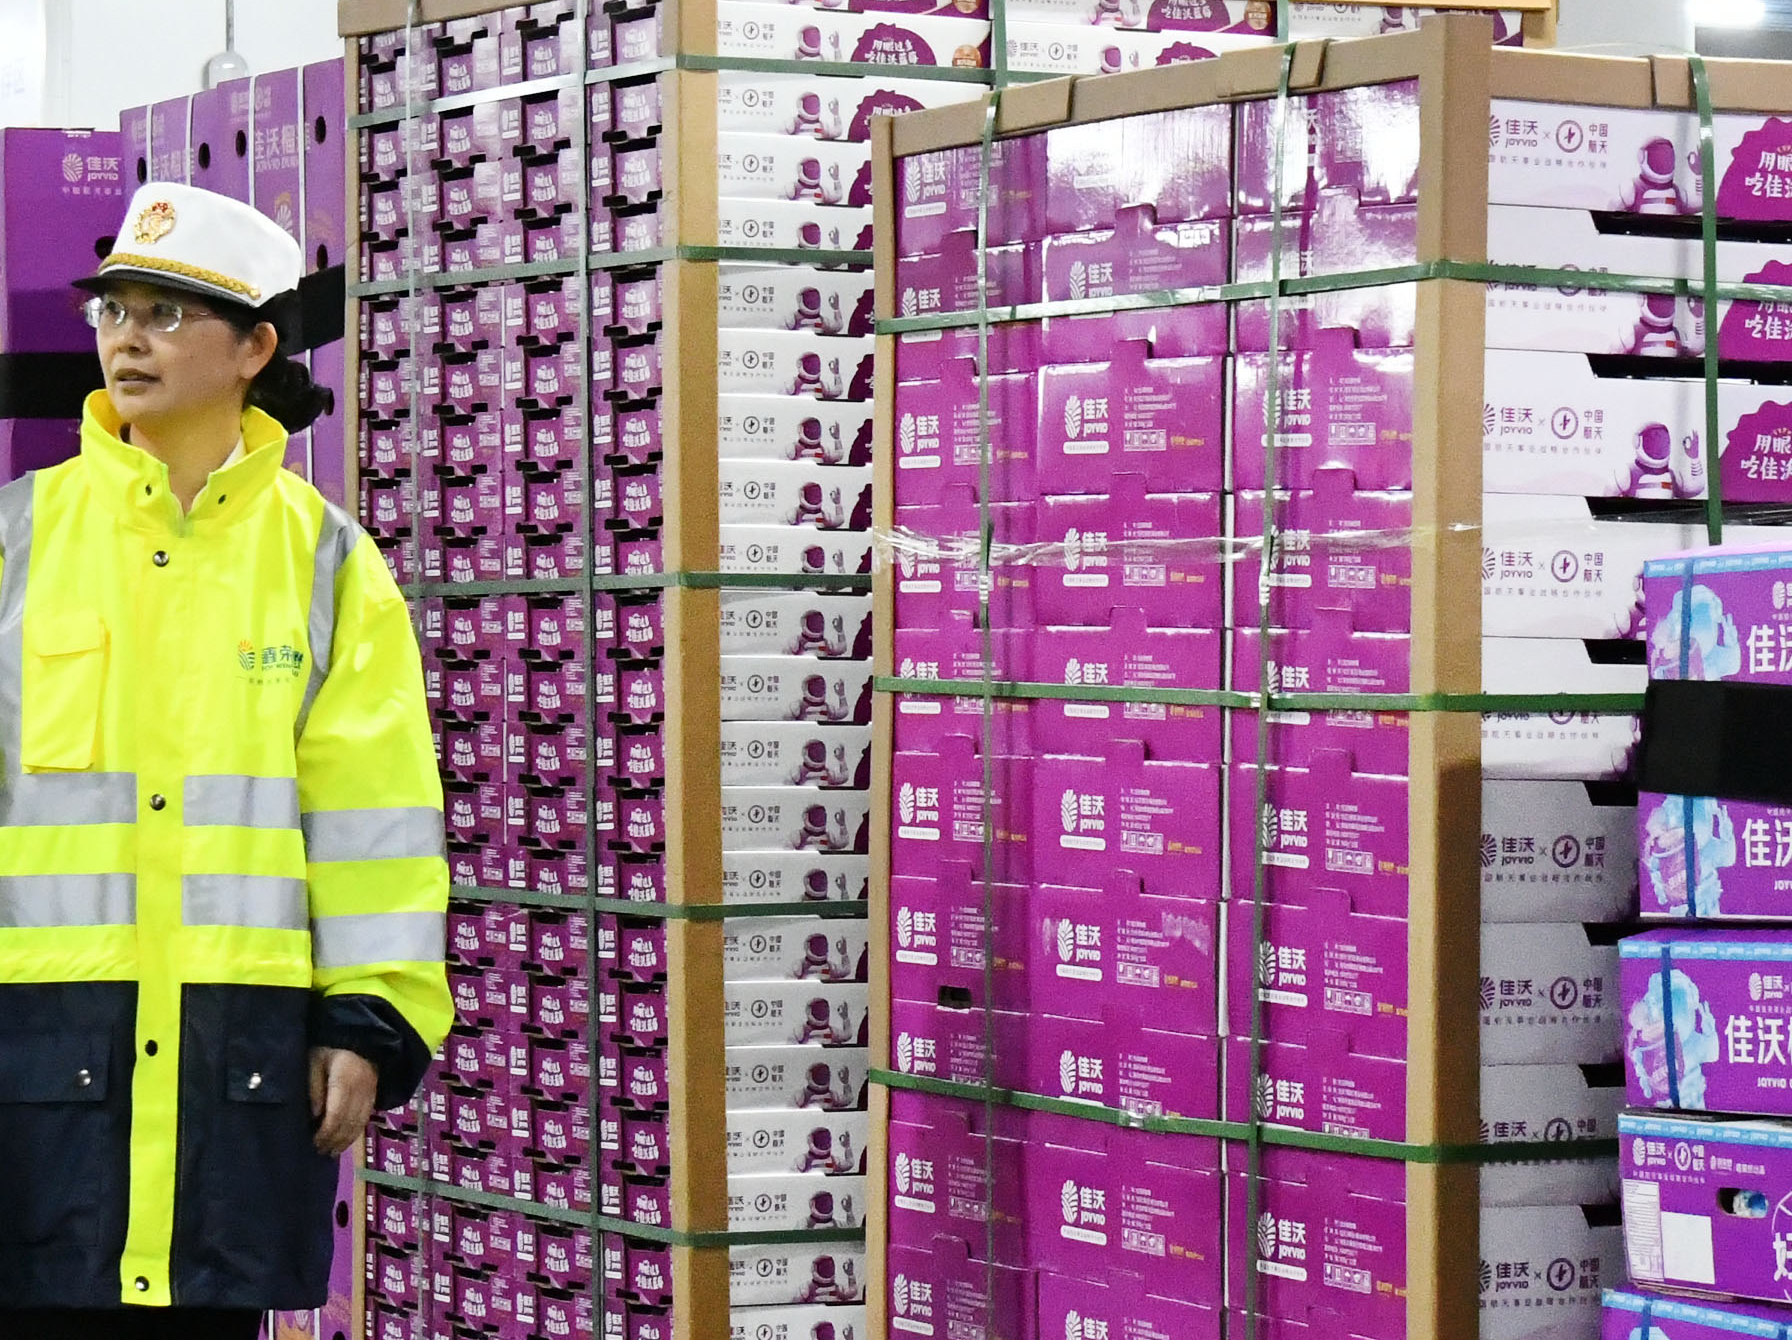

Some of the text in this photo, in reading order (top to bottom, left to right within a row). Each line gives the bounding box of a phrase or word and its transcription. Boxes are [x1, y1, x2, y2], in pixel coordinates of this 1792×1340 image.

[1506, 120, 1537, 134] 佳沃
[1589, 124, 1608, 137] 中国
[86, 157, 121, 174] 佳沃
[1077, 398, 1108, 422] 佳沃
[1501, 408, 1532, 422] 佳沃
[1584, 410, 1603, 423] 中国
[913, 416, 939, 435] 佳沃
[912, 788, 938, 807] 佳沃
[1076, 795, 1104, 815] 佳沃
[1280, 809, 1307, 831] 佳沃
[1502, 837, 1534, 857] 佳沃
[1072, 924, 1100, 946] 佳沃
[1274, 947, 1306, 970] 佳沃
[1500, 980, 1532, 995] 佳沃
[1757, 1077, 1786, 1088] JOYVIO
[1075, 1187, 1105, 1212] 佳沃
[1274, 1219, 1306, 1244] 佳沃
